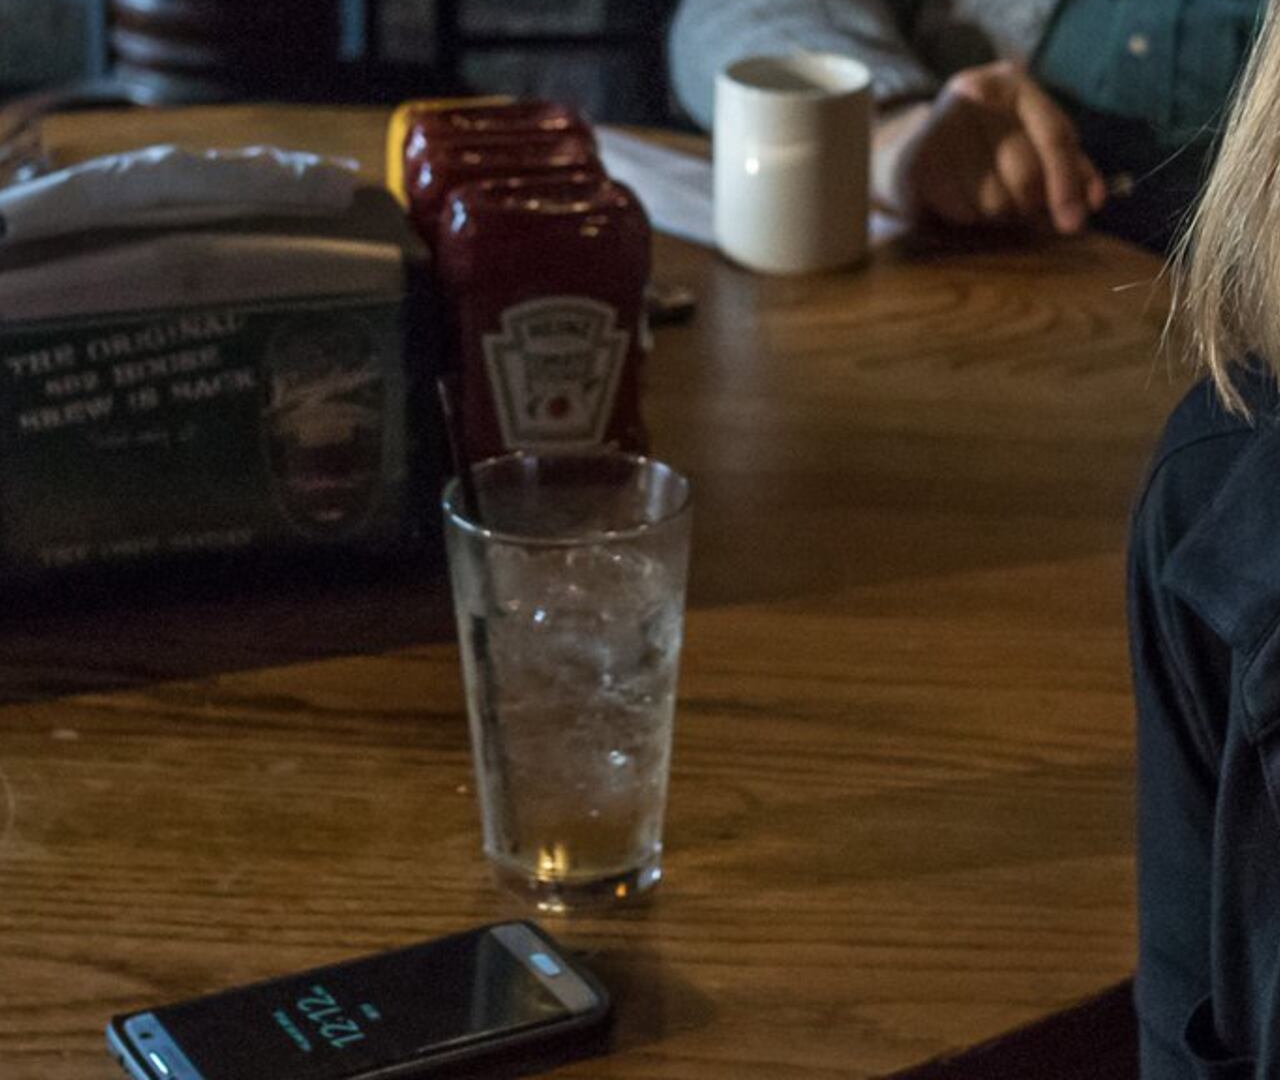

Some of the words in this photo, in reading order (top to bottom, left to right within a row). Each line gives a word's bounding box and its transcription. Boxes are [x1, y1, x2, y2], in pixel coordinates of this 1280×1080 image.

[6, 344, 75, 376] THE
[86, 317, 242, 360] ORIGINAL
[297, 985, 367, 1047] 12:12
